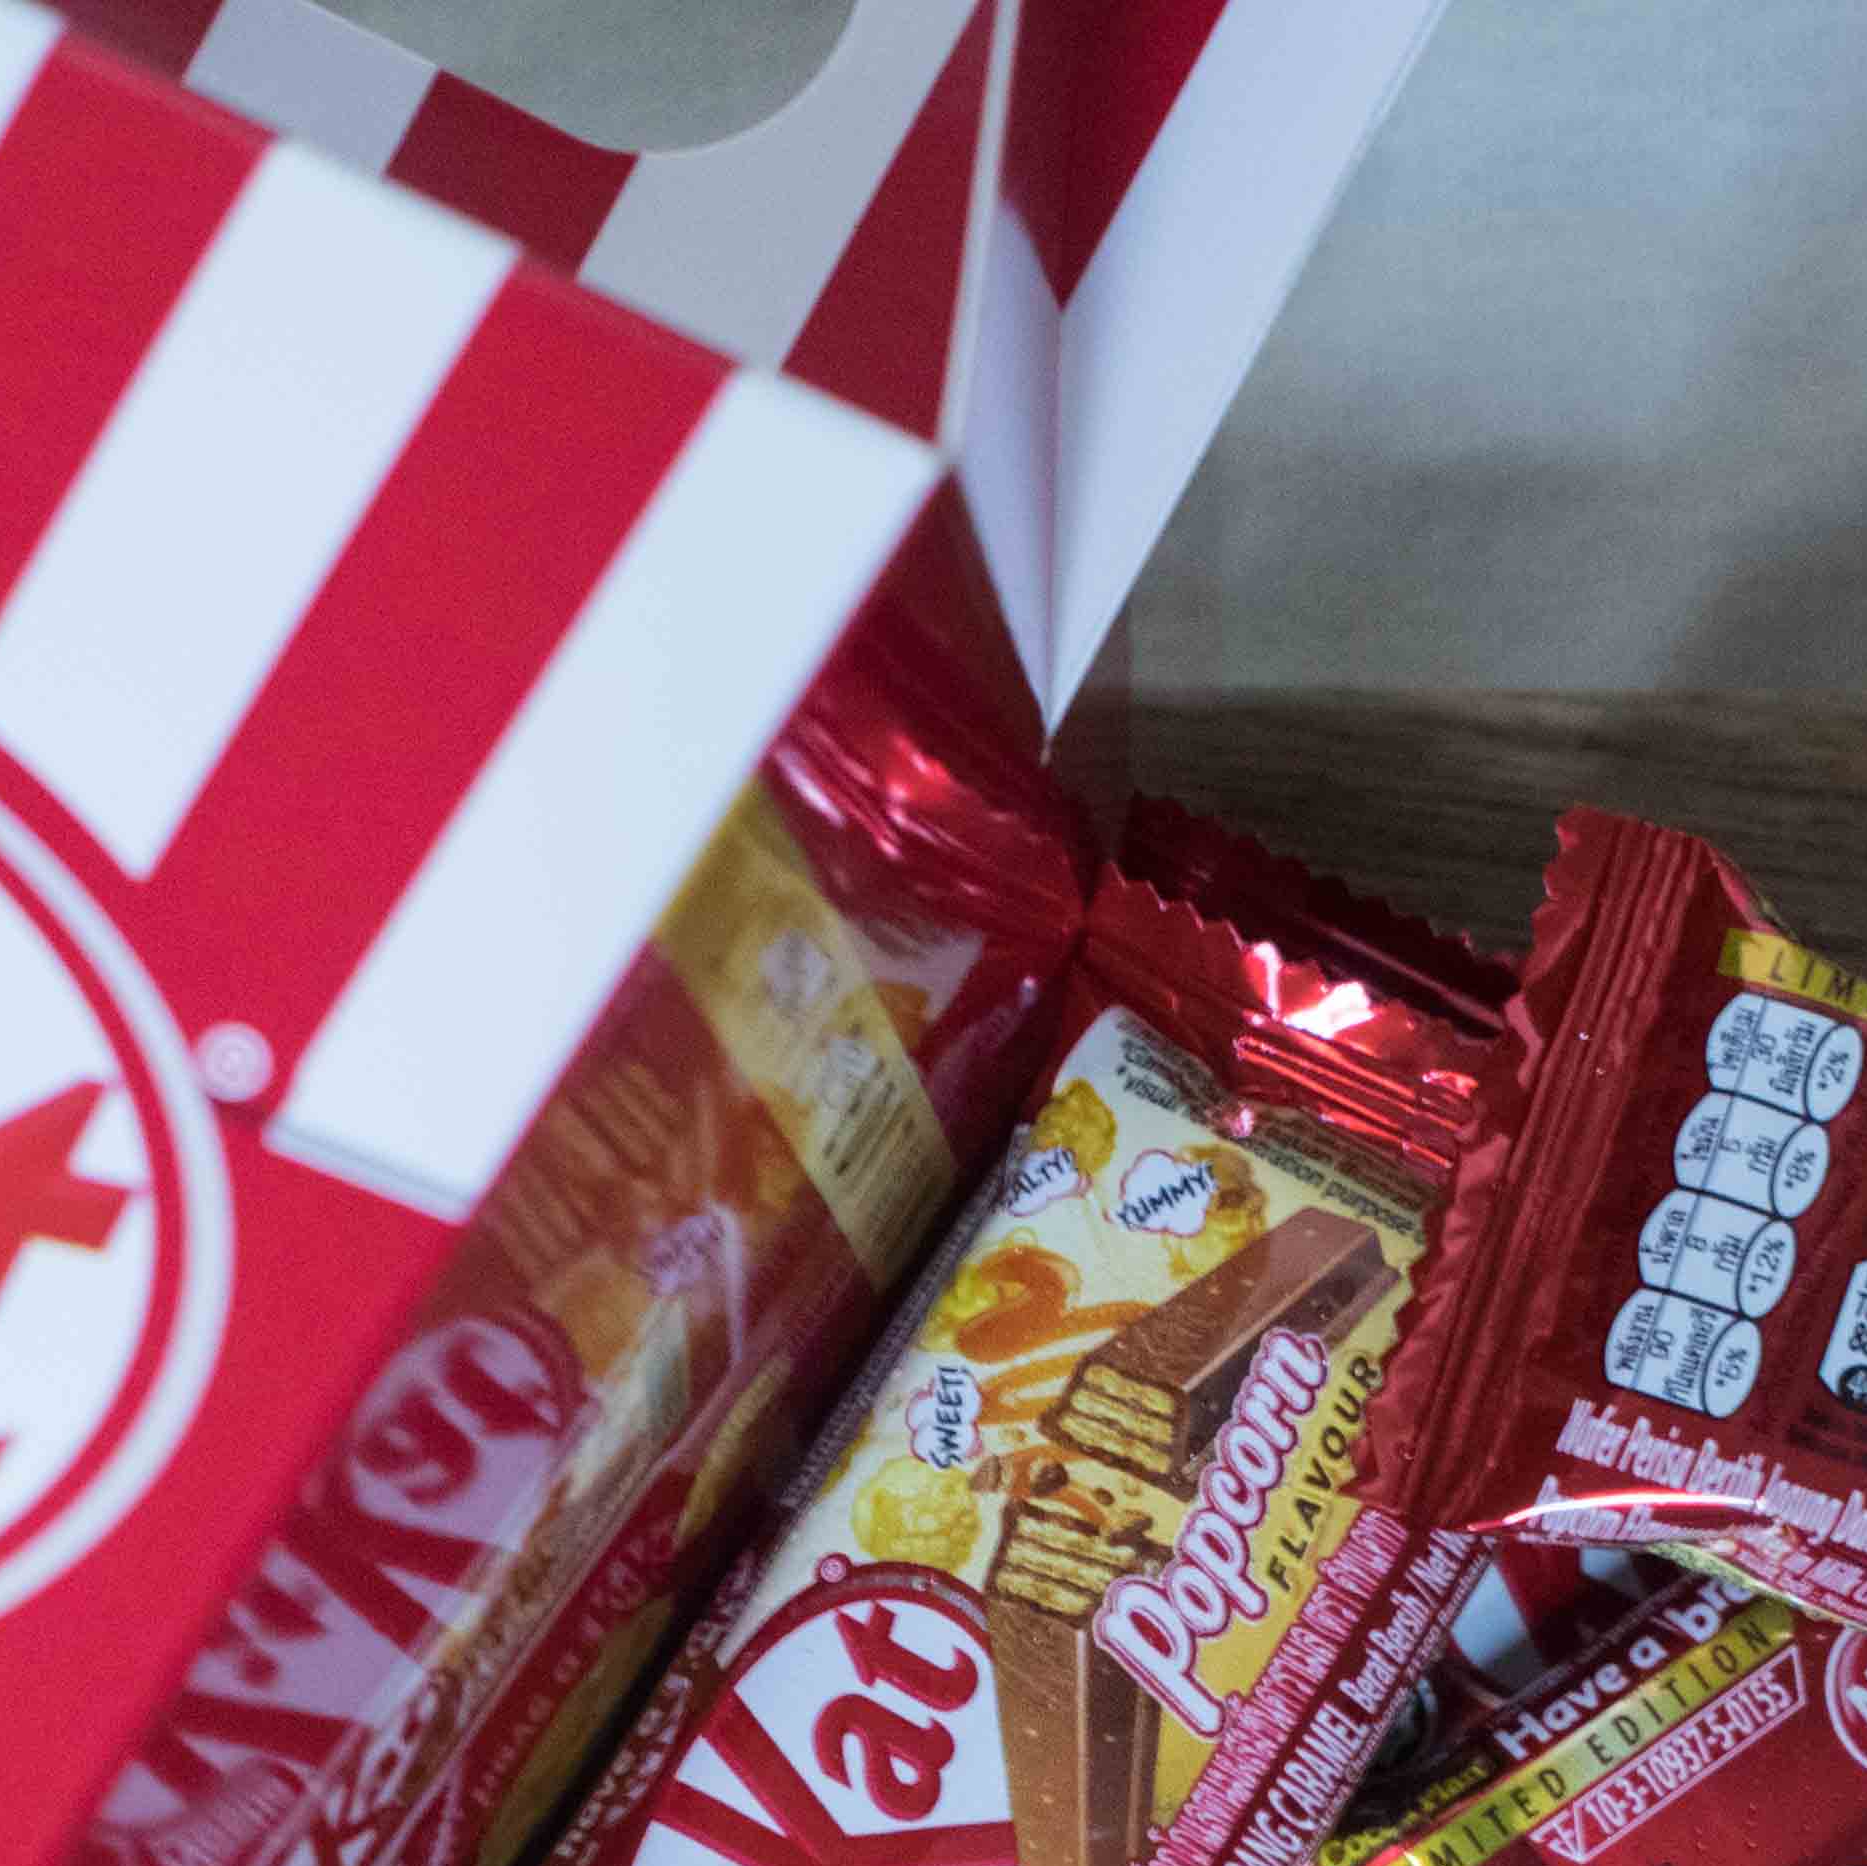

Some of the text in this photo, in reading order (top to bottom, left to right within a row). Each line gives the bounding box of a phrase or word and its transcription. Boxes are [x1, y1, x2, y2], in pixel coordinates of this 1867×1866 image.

[1114, 1160, 1218, 1229] YUMMY!
[934, 1365, 968, 1469] SWEET!
[1264, 1354, 1385, 1595] FLAVOUR
[1099, 1331, 1329, 1737] Popcorn
[1259, 1697, 1374, 1836] CARAMEL
[1495, 1663, 1631, 1761] Have
[1580, 1608, 1775, 1773] EDITION
[1580, 1658, 1796, 1843] 10-3-10937-5-0155
